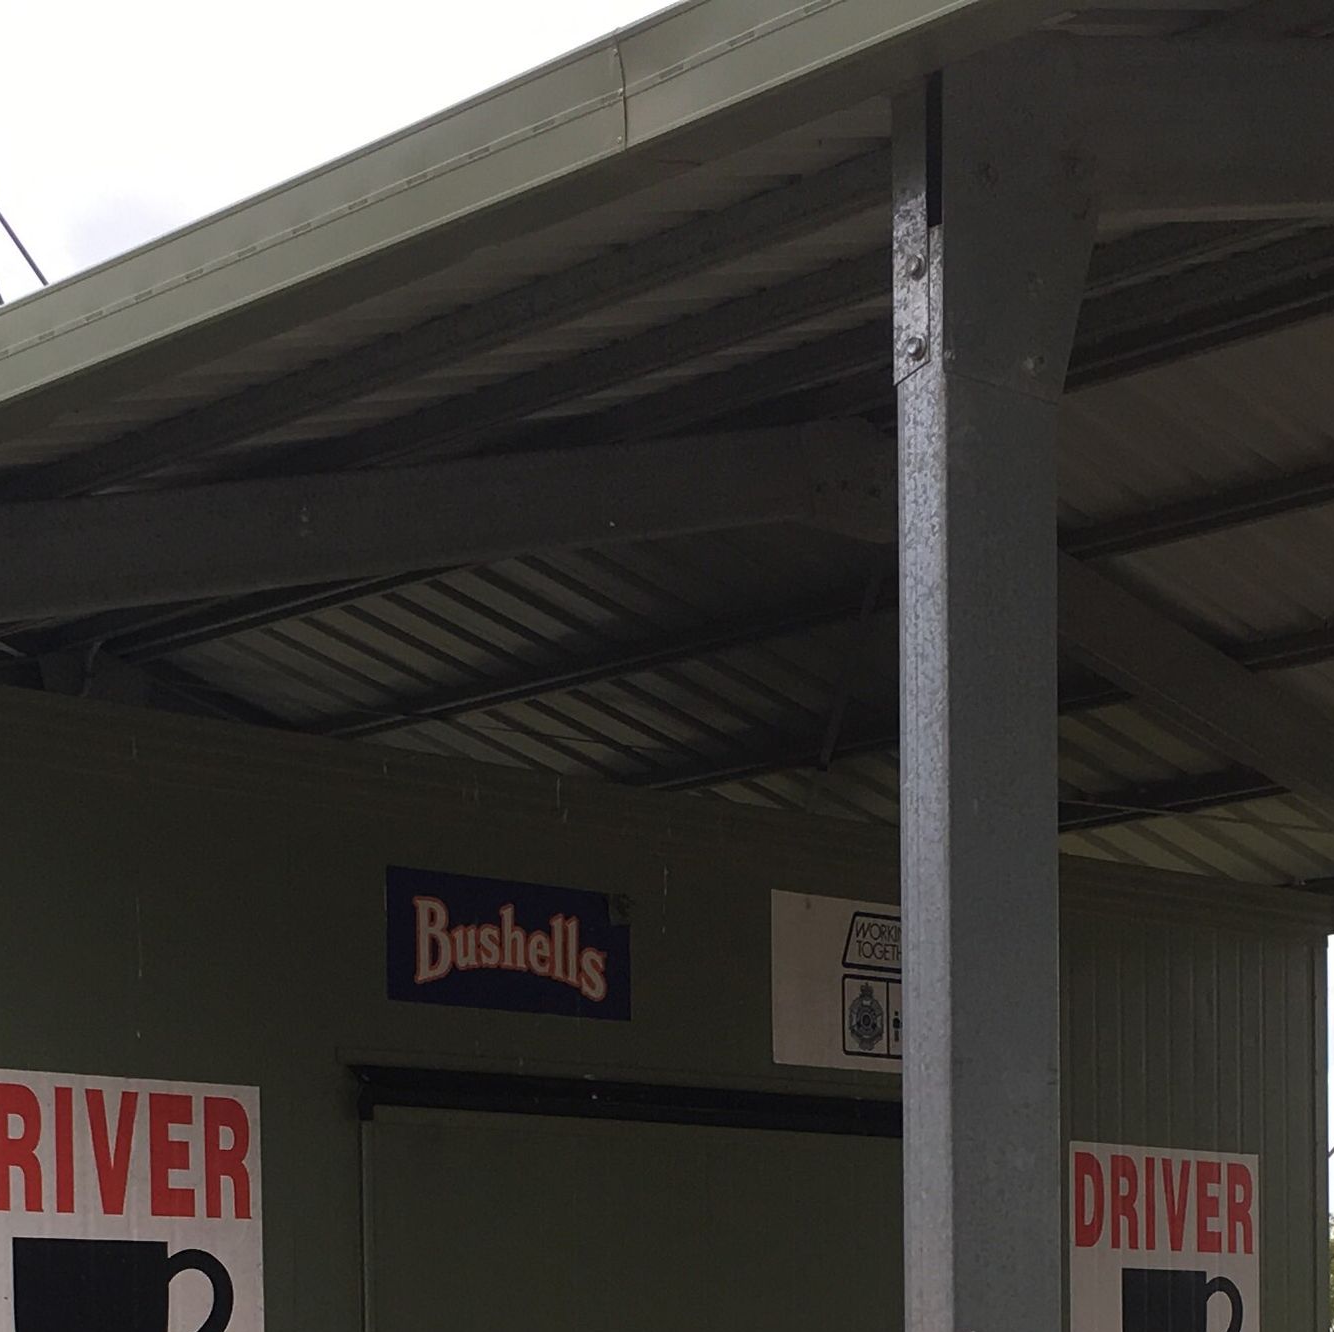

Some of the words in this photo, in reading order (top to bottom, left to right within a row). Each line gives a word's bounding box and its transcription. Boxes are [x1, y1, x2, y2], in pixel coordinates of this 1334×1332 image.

[413, 895, 608, 1002] Bushells
[856, 940, 902, 961] TOGETH
[1074, 1151, 1254, 1254] DRIVER
